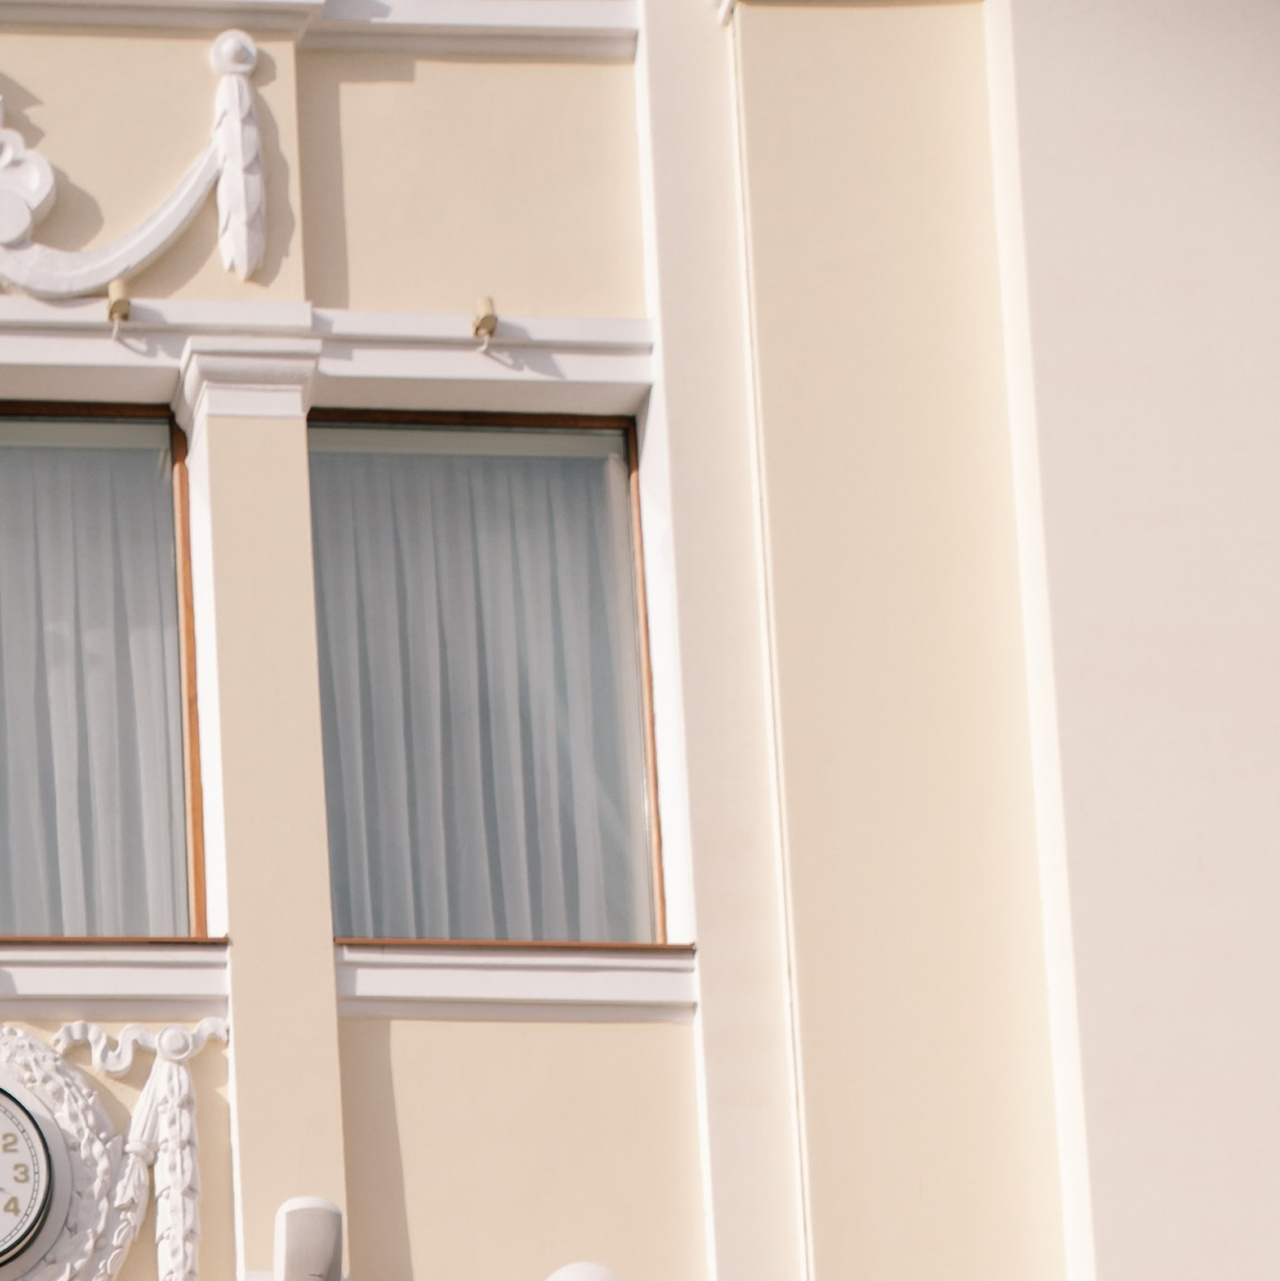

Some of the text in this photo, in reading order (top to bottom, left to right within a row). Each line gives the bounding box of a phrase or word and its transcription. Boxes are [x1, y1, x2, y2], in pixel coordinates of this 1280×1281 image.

[1, 1133, 18, 1153] 2
[13, 1164, 30, 1184] 3
[3, 1196, 21, 1217] 4
